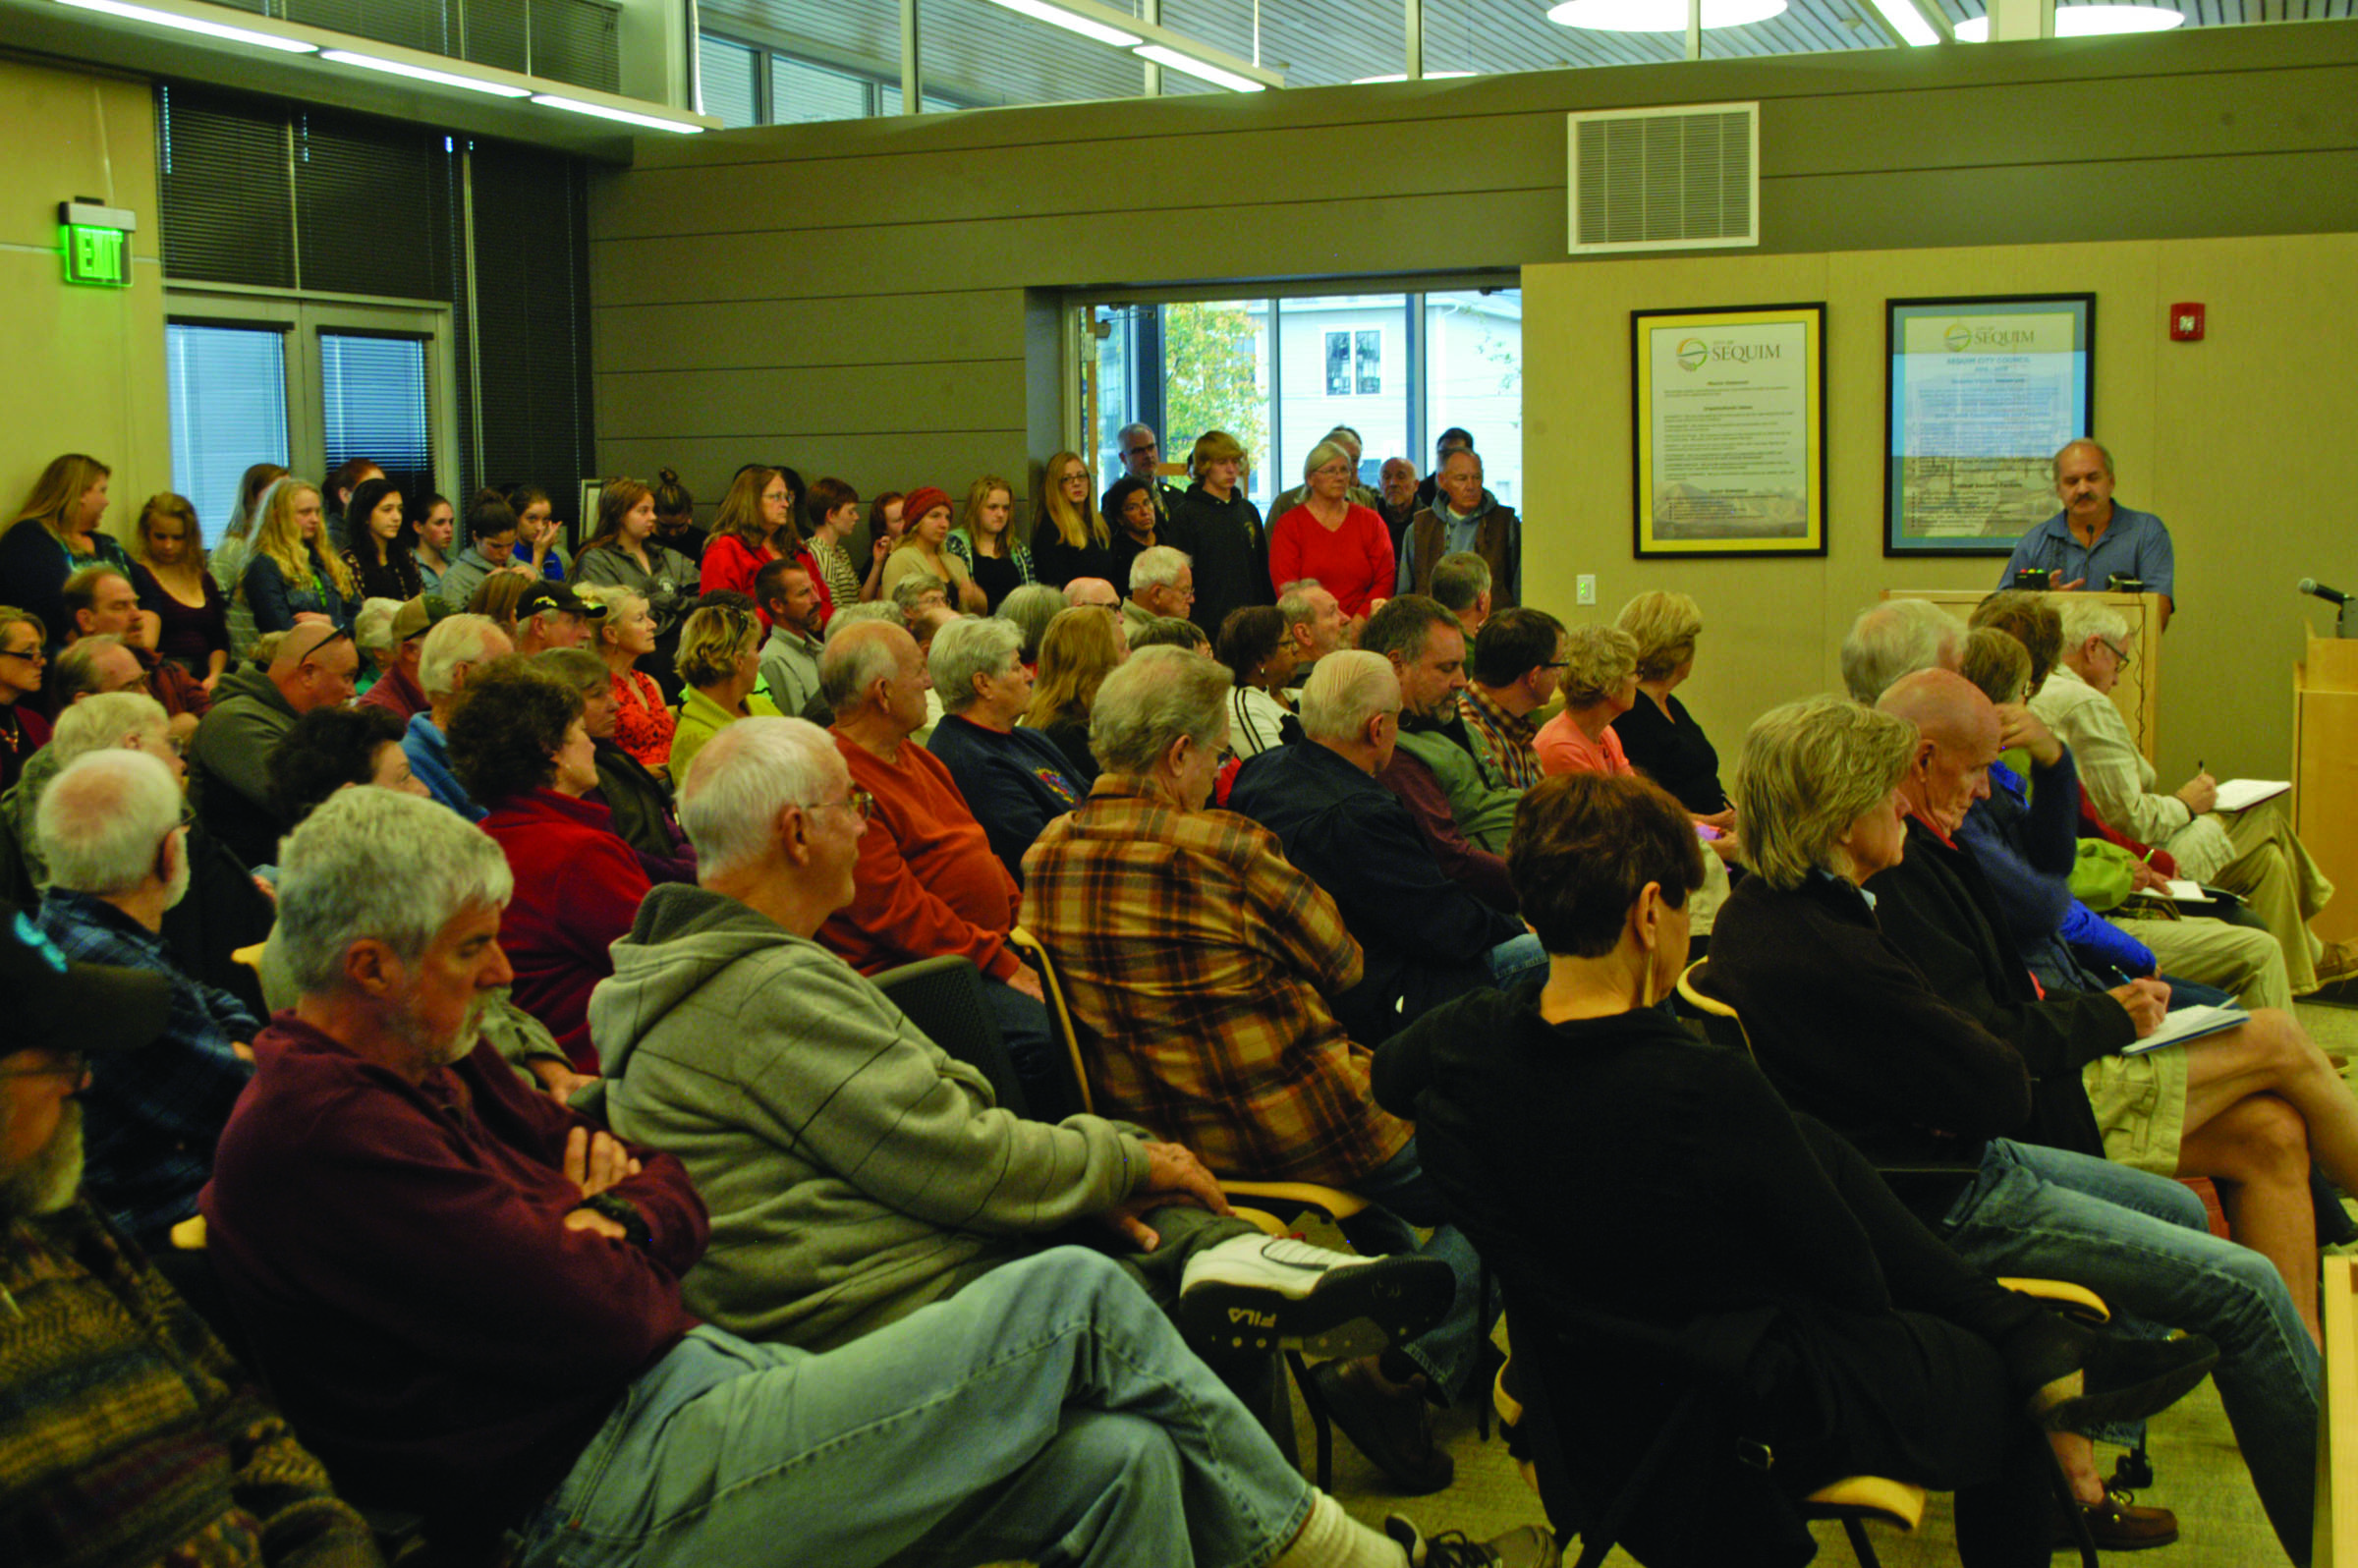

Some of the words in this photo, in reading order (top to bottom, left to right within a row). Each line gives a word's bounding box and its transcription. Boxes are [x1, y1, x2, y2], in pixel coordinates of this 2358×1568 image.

[78, 229, 124, 280] EXIT
[1974, 330, 2035, 346] SEQUIM
[1712, 344, 1781, 364] SEQUIM
[1227, 1308, 1276, 1328] FILA
